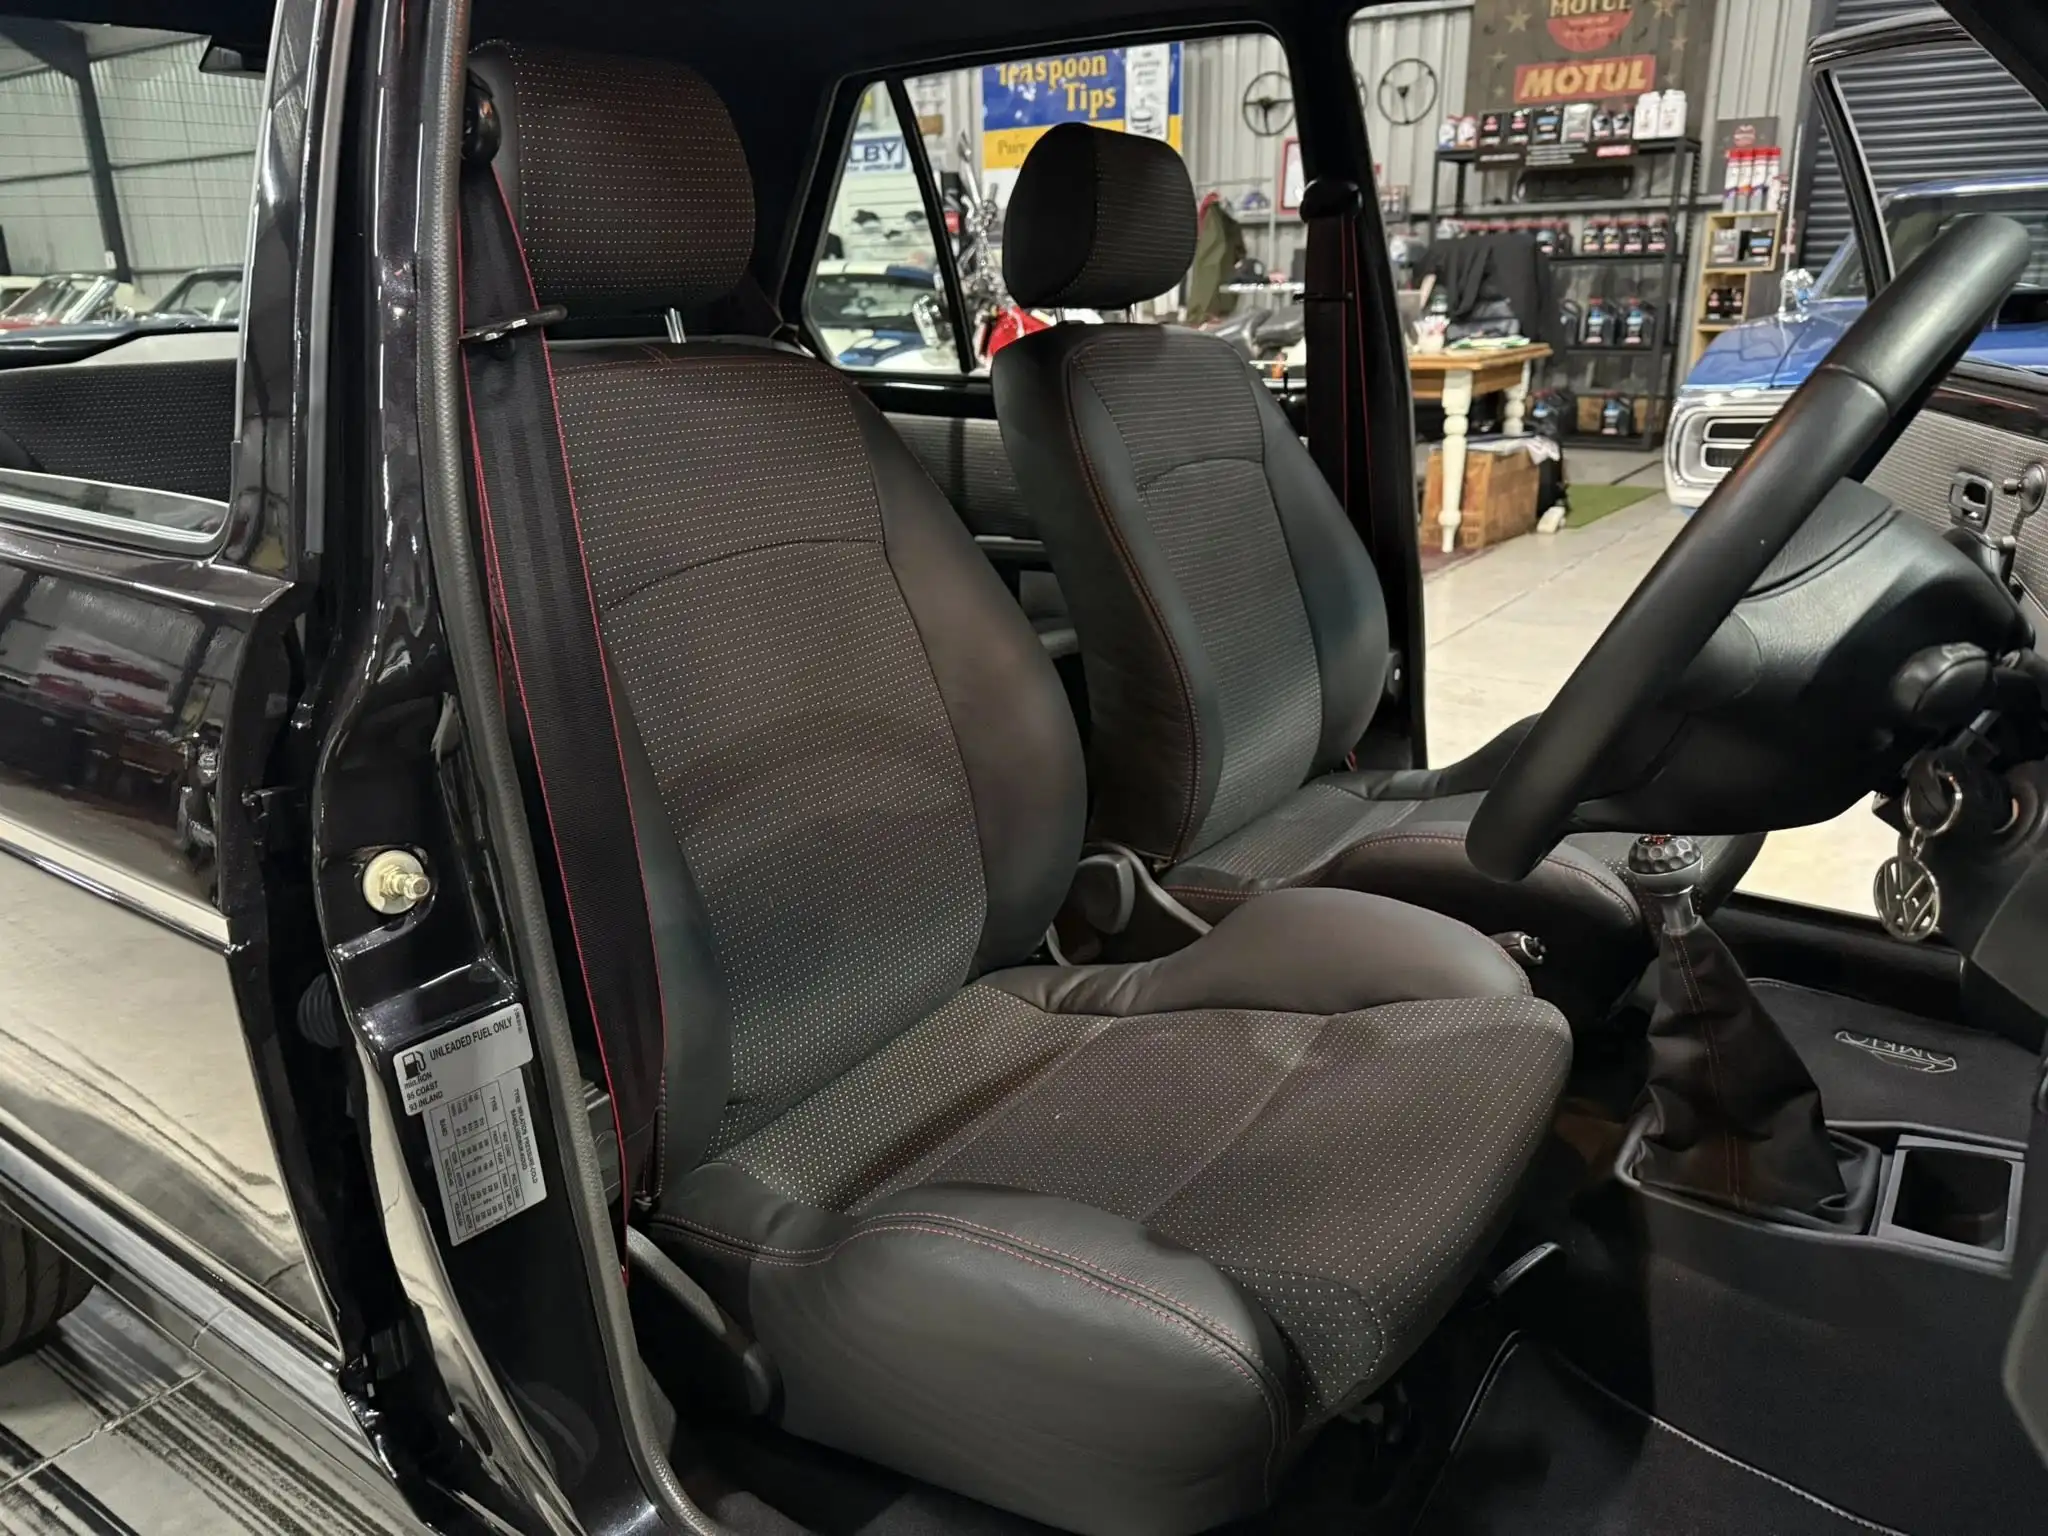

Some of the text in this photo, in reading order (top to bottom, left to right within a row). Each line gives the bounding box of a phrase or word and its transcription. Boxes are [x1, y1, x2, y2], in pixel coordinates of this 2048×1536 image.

[1550, 0, 1633, 17] MOTUL
[1520, 60, 1647, 98] MOTUL
[1063, 82, 1117, 119] Tips
[429, 1035, 472, 1061] UNLEADED
[472, 1026, 493, 1043] FUEL
[493, 1016, 513, 1034] ONLY
[406, 1080, 439, 1101] 95 COAST
[408, 1103, 418, 1112] 93
[418, 1090, 444, 1110] INLAND
